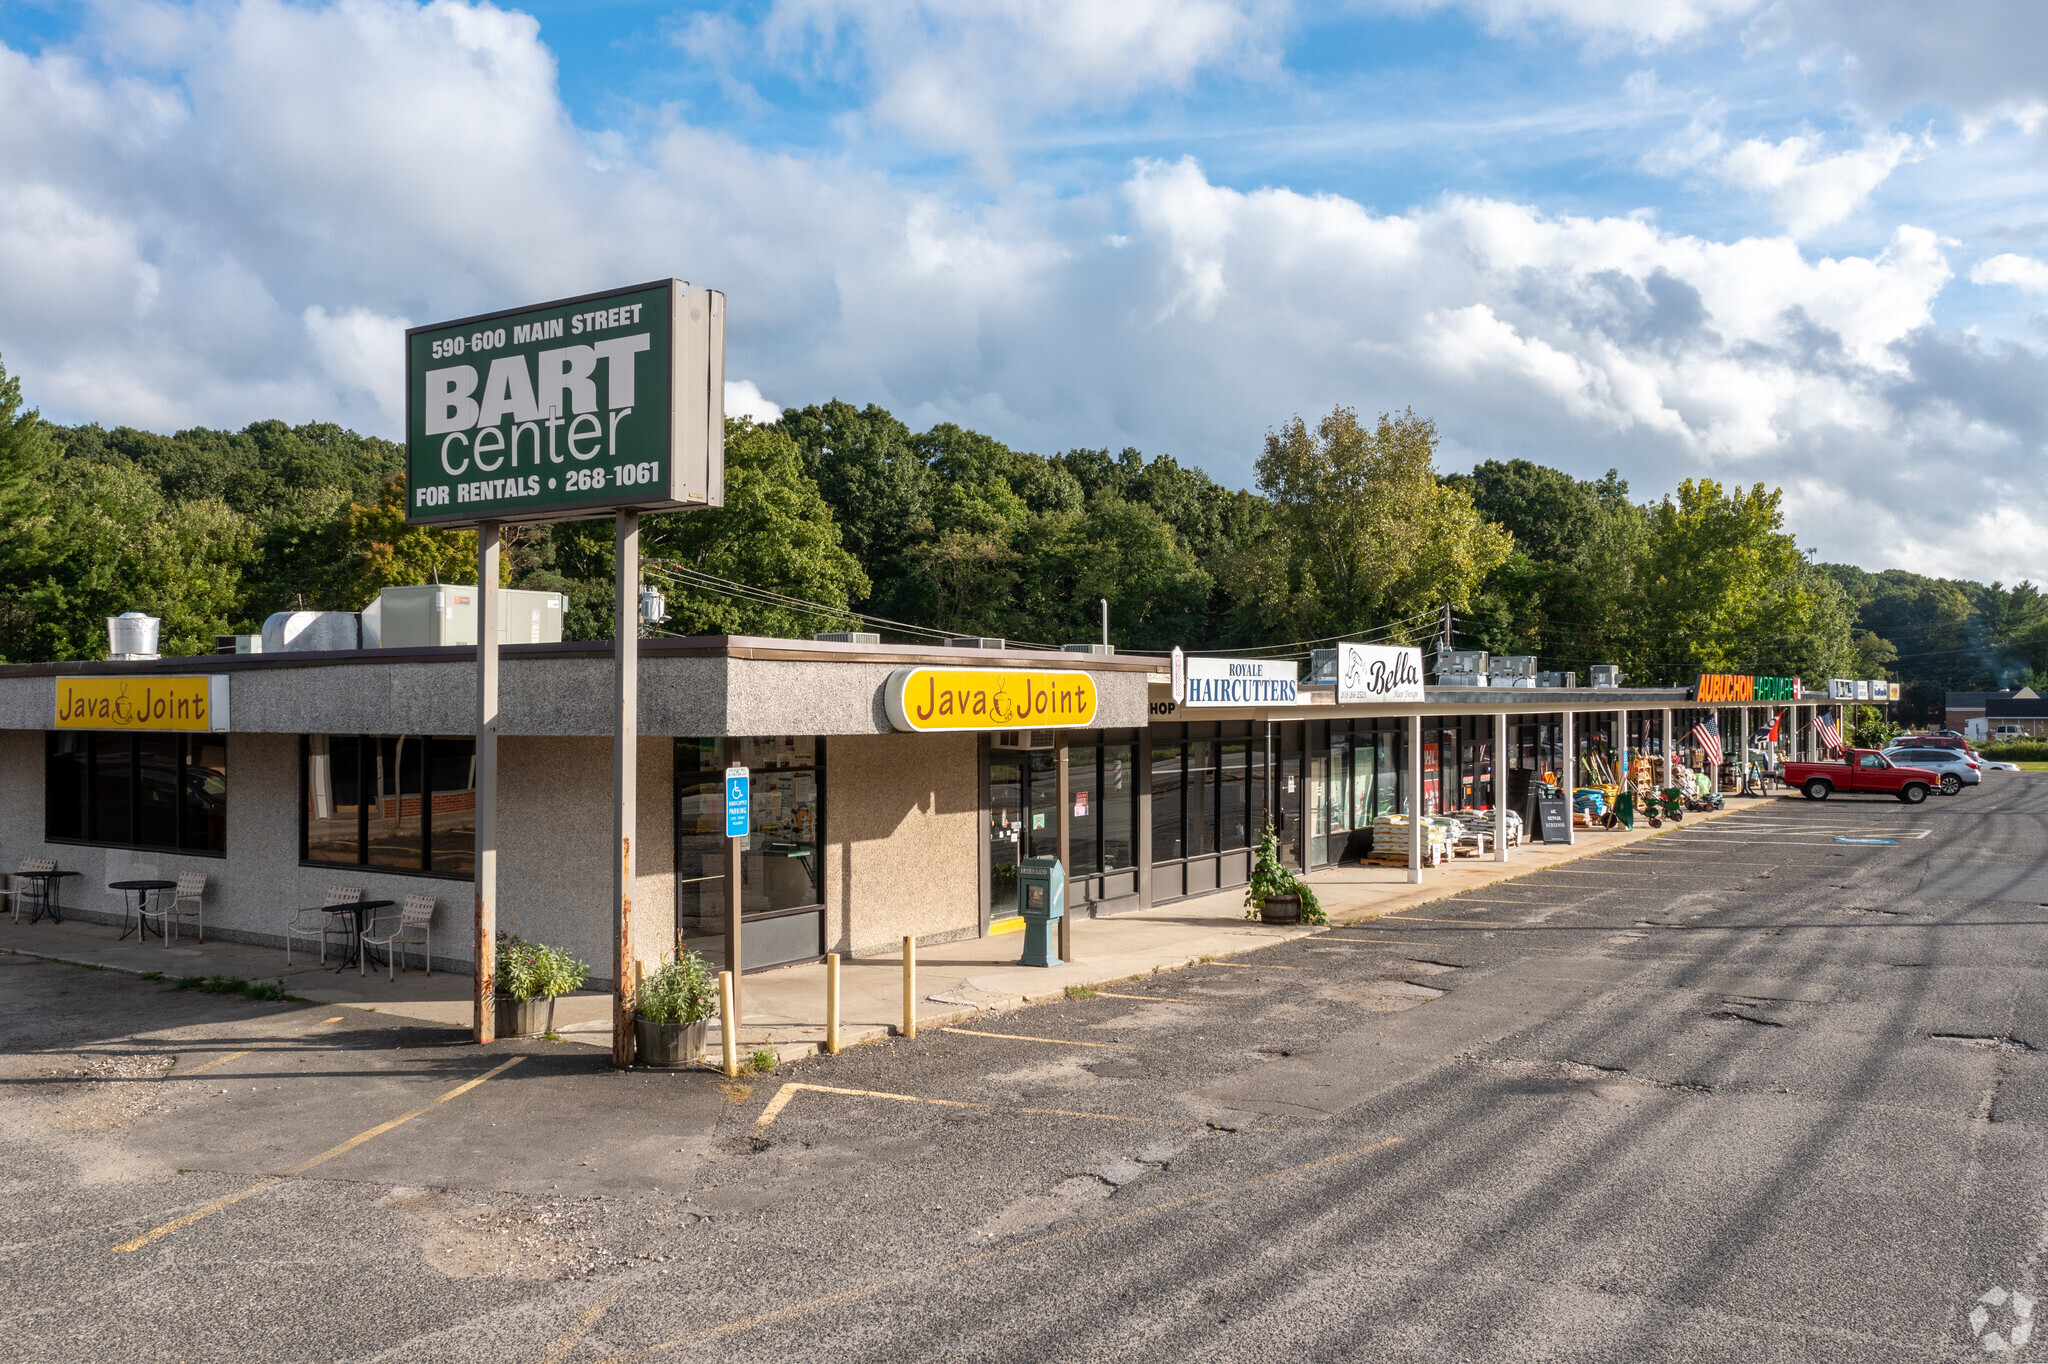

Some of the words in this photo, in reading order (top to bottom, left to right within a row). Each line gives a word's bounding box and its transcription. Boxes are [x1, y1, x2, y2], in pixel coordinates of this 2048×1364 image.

[432, 328, 506, 359] 590-600
[513, 318, 564, 345] MAIN
[571, 303, 642, 333] STREET
[425, 332, 650, 436] BART
[441, 405, 633, 476] center
[416, 485, 450, 507] FOR
[457, 475, 540, 503] RENTALS
[565, 461, 659, 492] 268-1061
[1188, 677, 1296, 703] HAIRCUTTERS
[1229, 663, 1263, 677] ROYALE
[1367, 651, 1419, 694] Bella
[1697, 673, 1753, 703] AUBUCHON
[1753, 675, 1794, 701] HARDWARE
[59, 687, 110, 722] Java
[137, 687, 205, 723] Joint
[916, 676, 986, 721] Java
[1016, 678, 1087, 719] Joint
[1148, 702, 1176, 715] HOP
